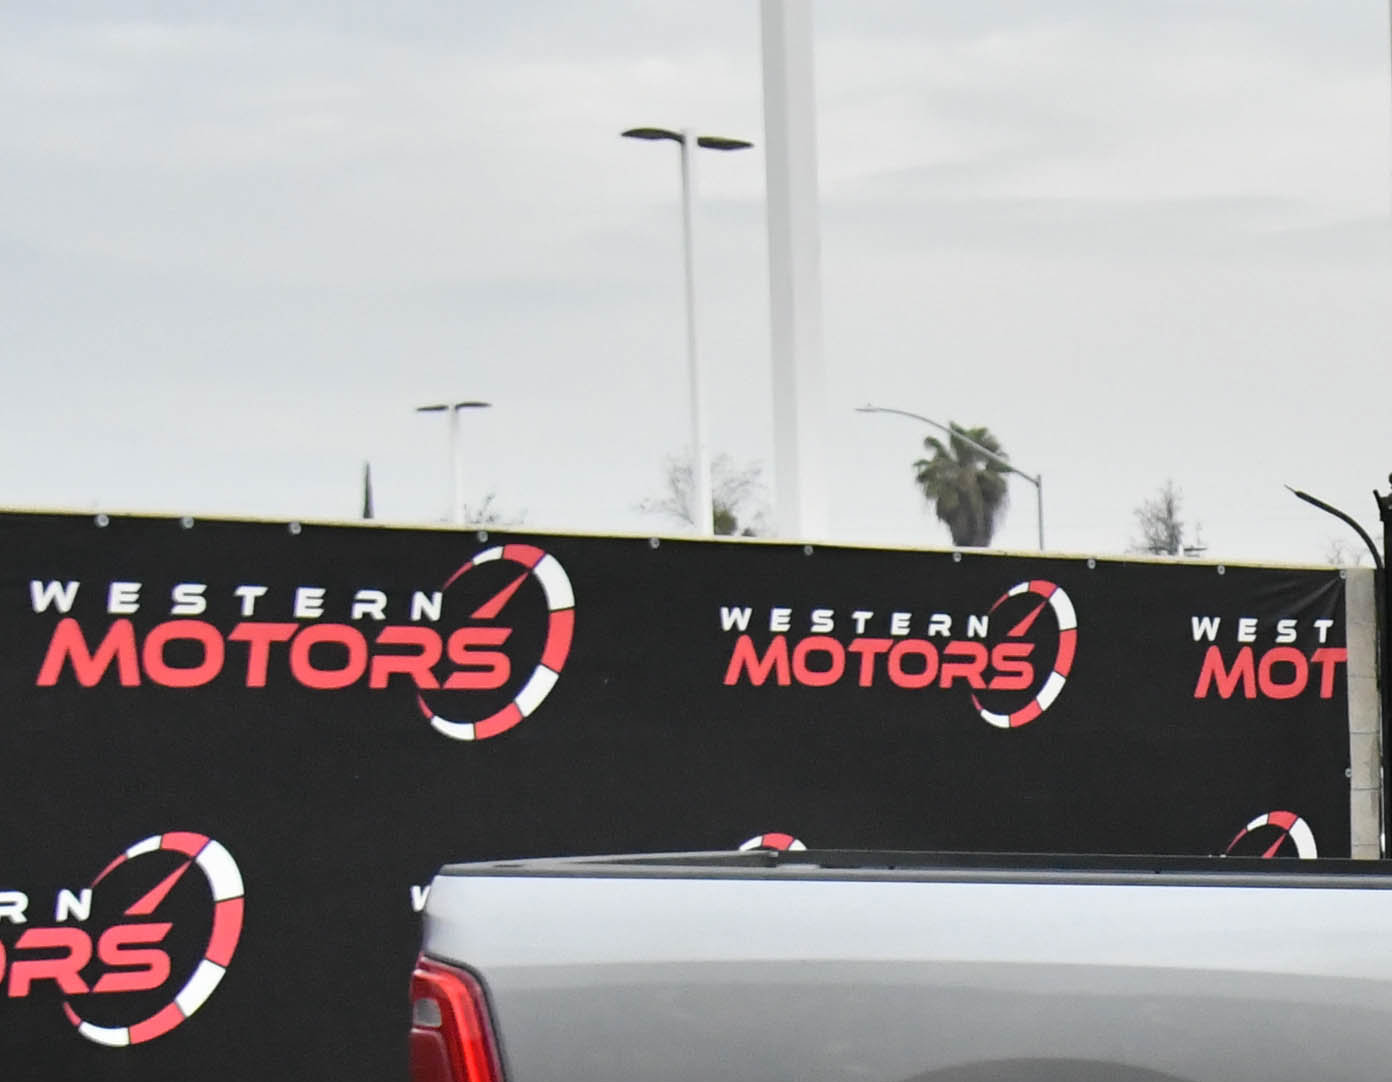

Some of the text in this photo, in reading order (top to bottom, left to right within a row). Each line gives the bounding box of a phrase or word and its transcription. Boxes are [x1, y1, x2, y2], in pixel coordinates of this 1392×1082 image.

[31, 580, 443, 621] WESTERN
[720, 607, 989, 638] WESTERN
[36, 617, 513, 690] MOTORS
[1191, 616, 1334, 643] WEST
[723, 635, 1035, 690] MOTORS
[1193, 645, 1348, 699] MOT
[0, 922, 173, 998] RS
